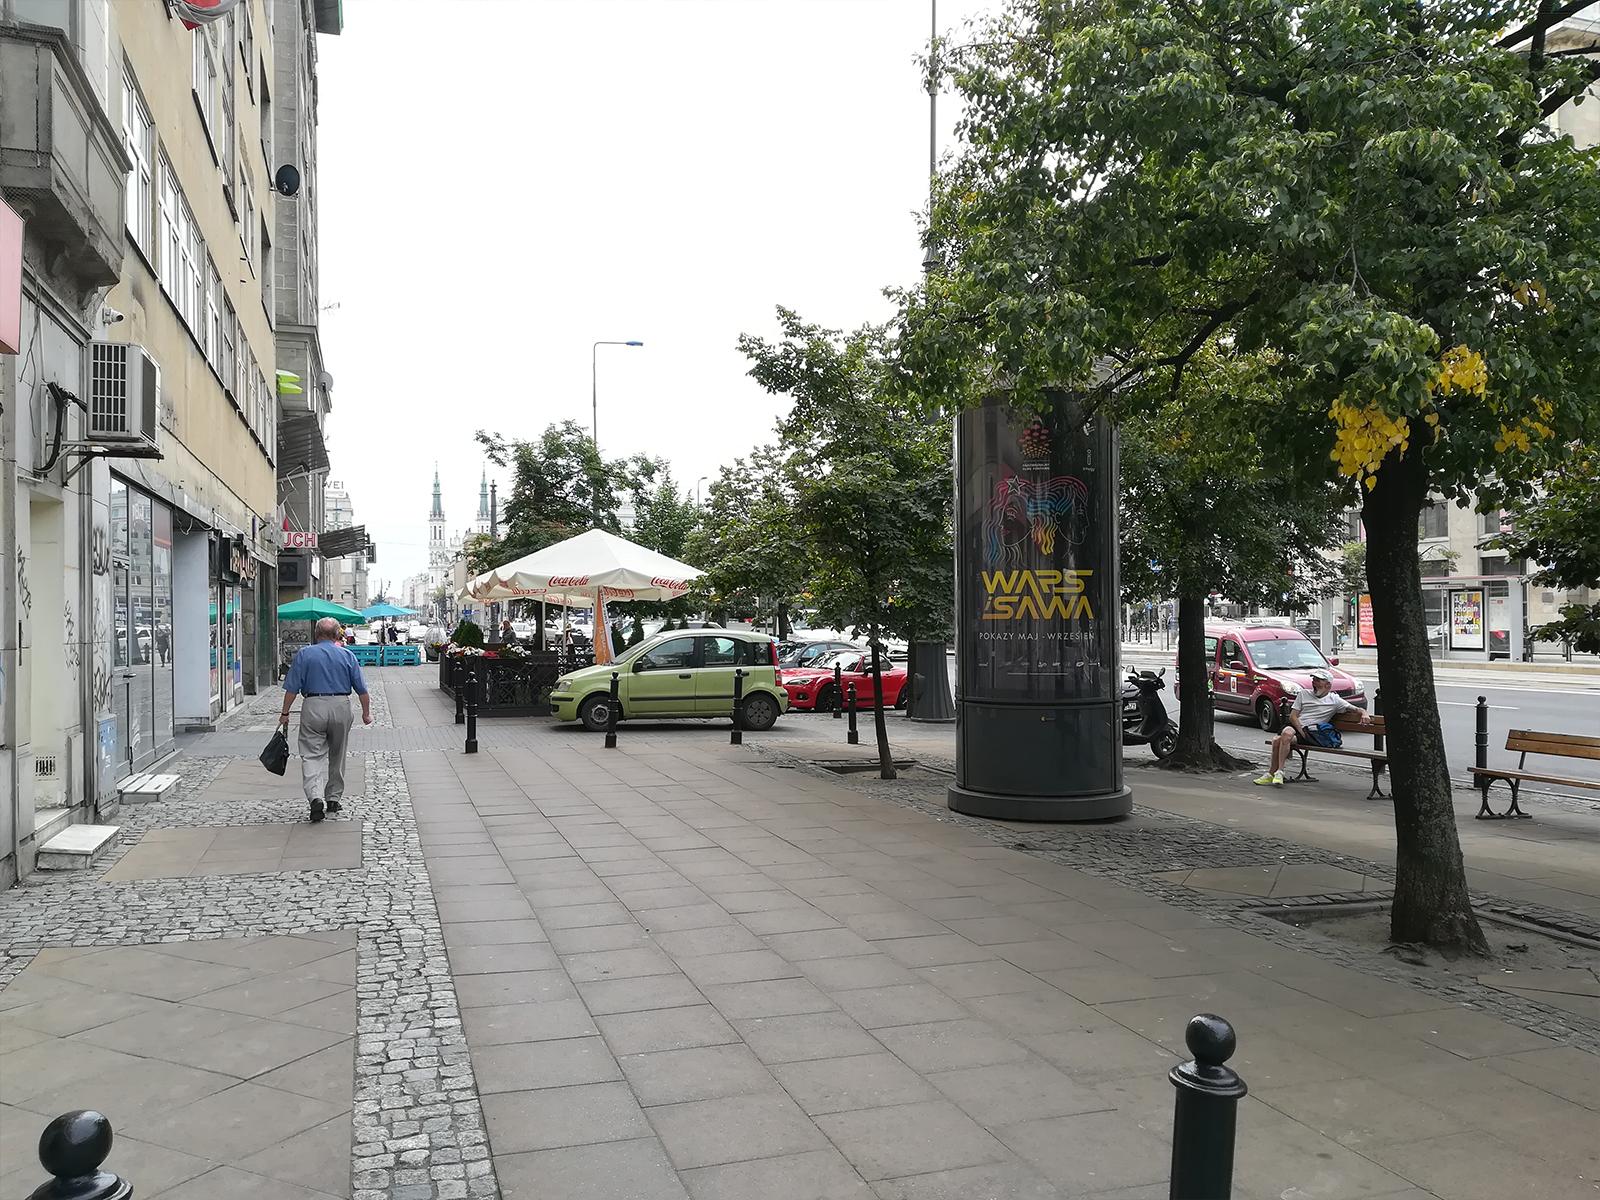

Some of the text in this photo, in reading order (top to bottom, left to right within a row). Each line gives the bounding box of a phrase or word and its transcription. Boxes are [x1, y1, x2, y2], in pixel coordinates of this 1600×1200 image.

[981, 569, 1094, 594] WARS
[982, 595, 1094, 620] SAWA
[979, 632, 1014, 641] POKAZY
[1018, 632, 1039, 641] MAJ
